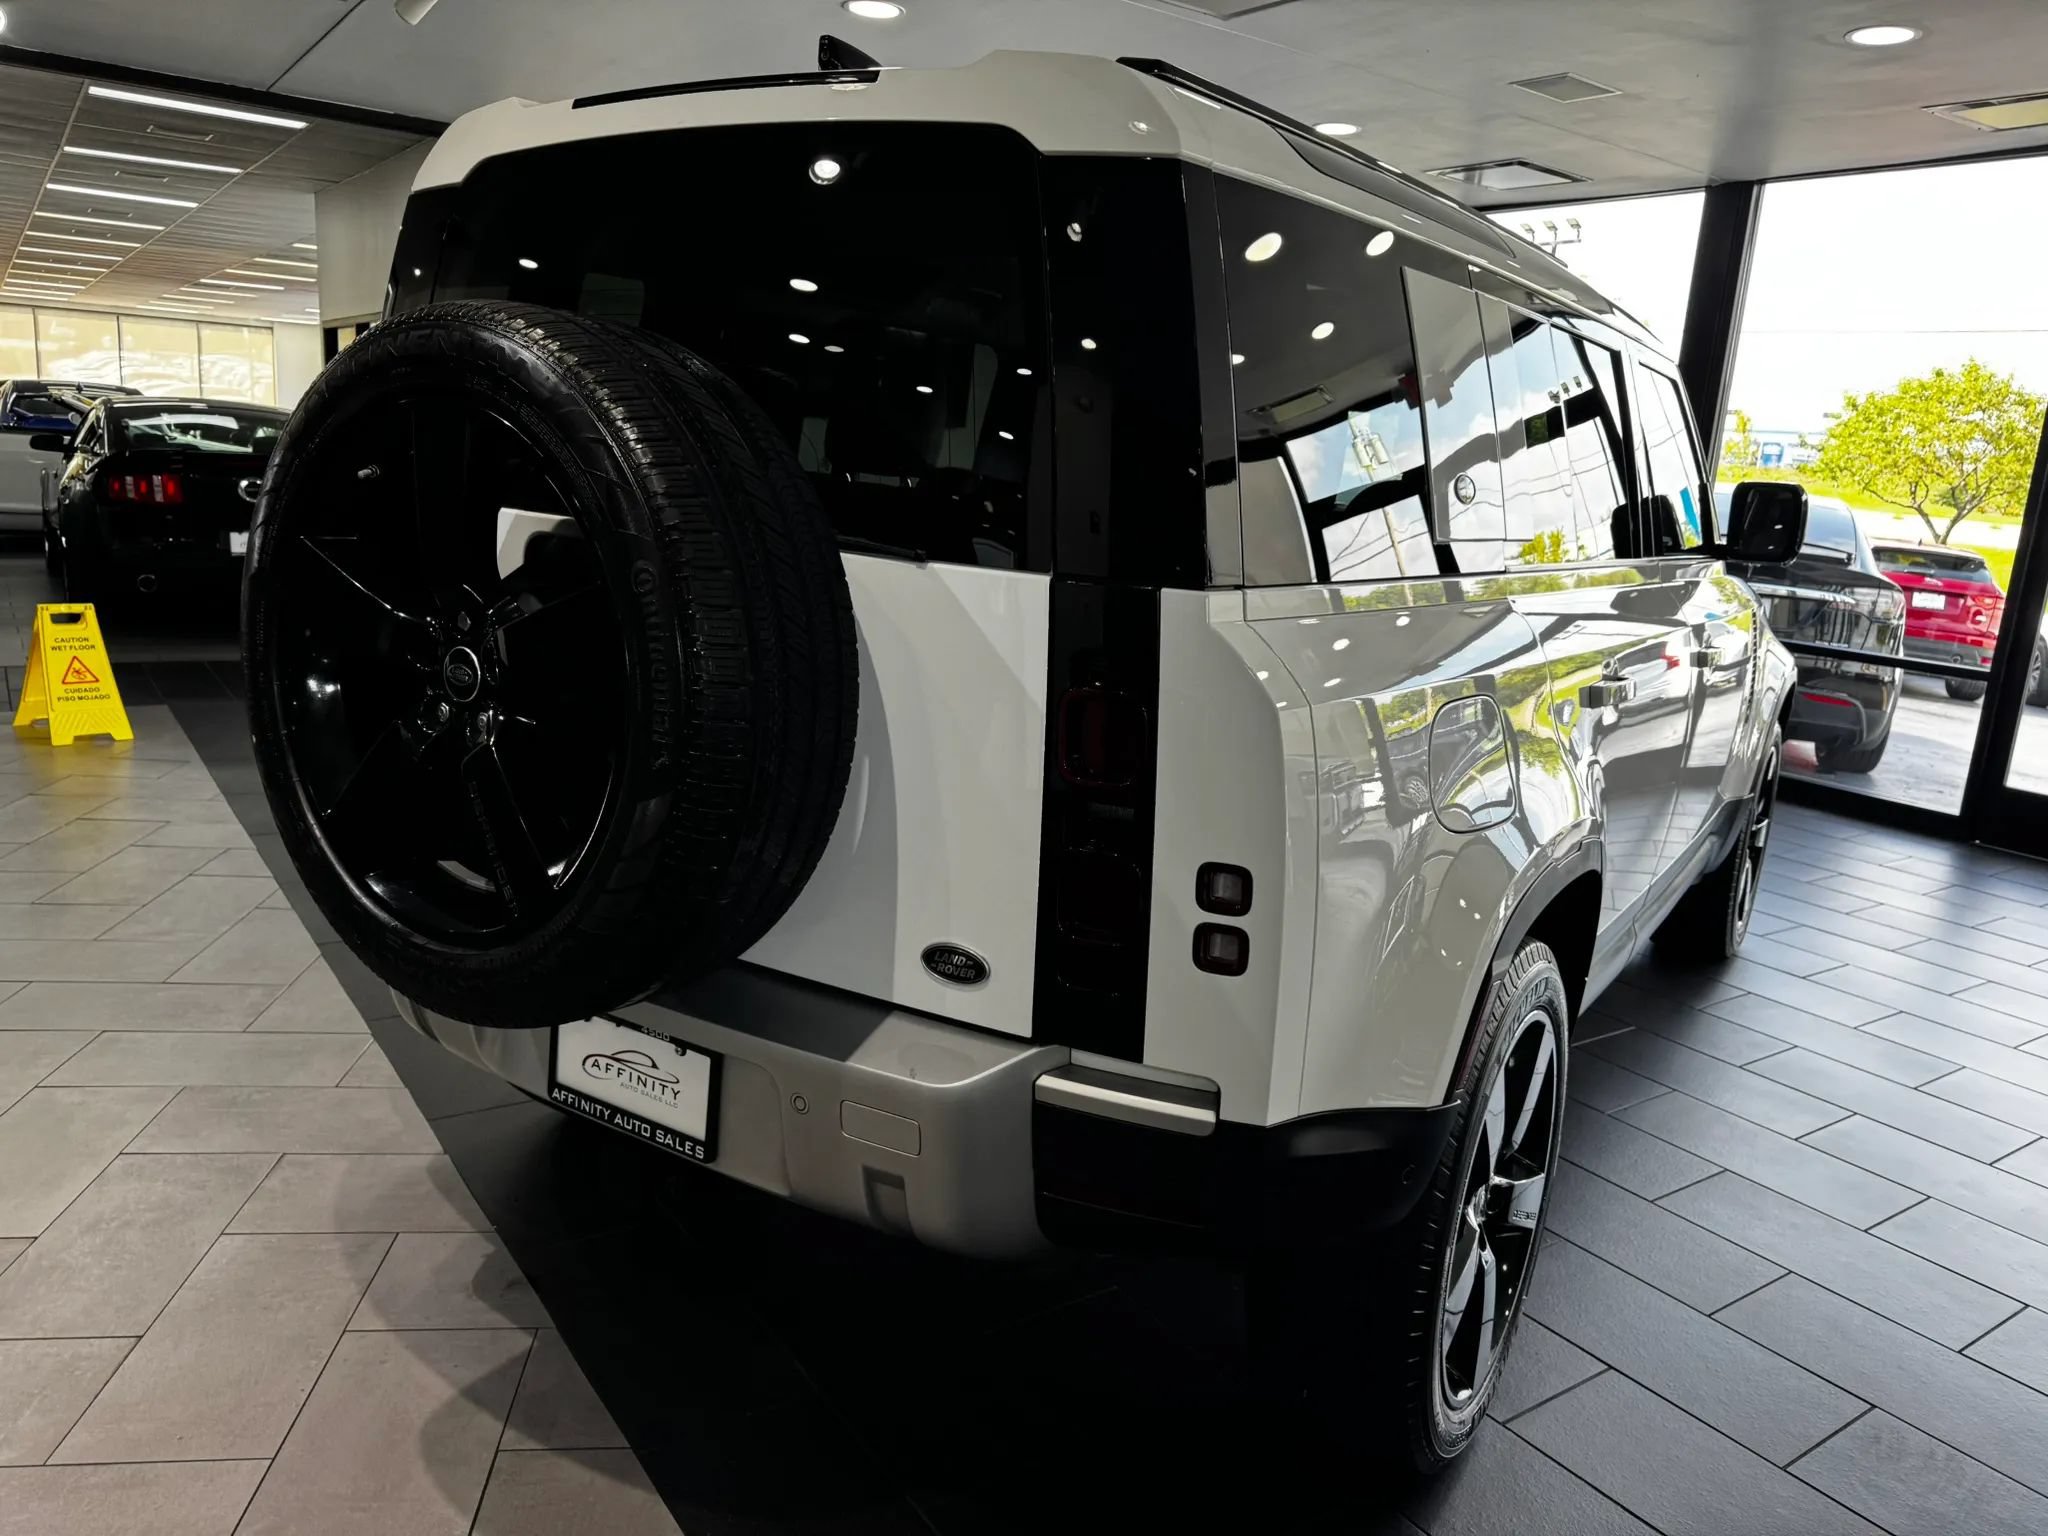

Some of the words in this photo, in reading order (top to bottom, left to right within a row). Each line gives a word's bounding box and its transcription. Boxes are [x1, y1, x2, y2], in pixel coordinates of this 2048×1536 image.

[590, 1058, 681, 1101] AFFINITY
[619, 1081, 639, 1094] AUTO
[640, 1088, 664, 1103] SALES
[665, 1099, 679, 1109] LLC
[551, 1088, 611, 1120] AFFINITY
[614, 1113, 651, 1138] AUTO
[655, 1128, 705, 1160] SALES
